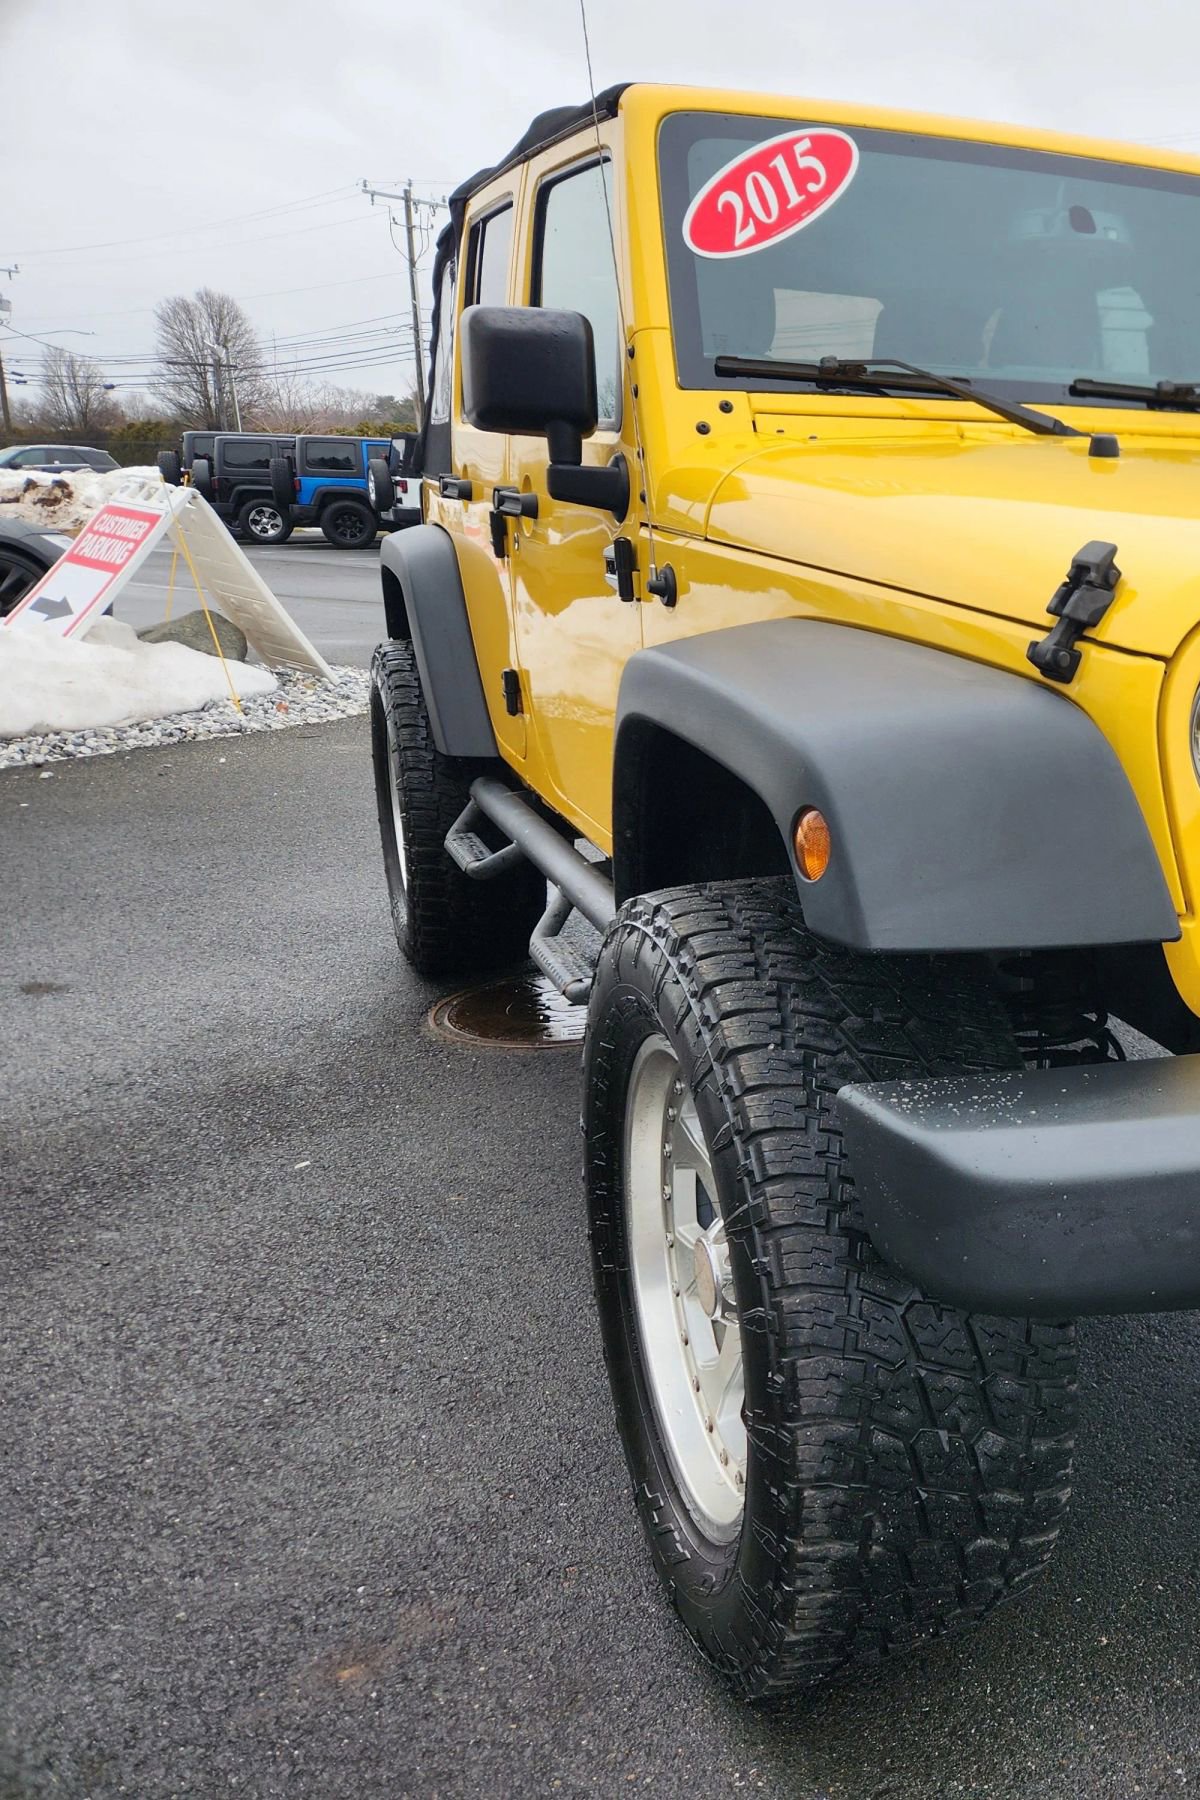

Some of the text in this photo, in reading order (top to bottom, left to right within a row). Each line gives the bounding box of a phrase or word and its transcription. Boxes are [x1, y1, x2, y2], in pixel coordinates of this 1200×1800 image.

[717, 137, 827, 248] 2015
[93, 513, 150, 540] CUSTOMER
[73, 532, 135, 565] PARKING
